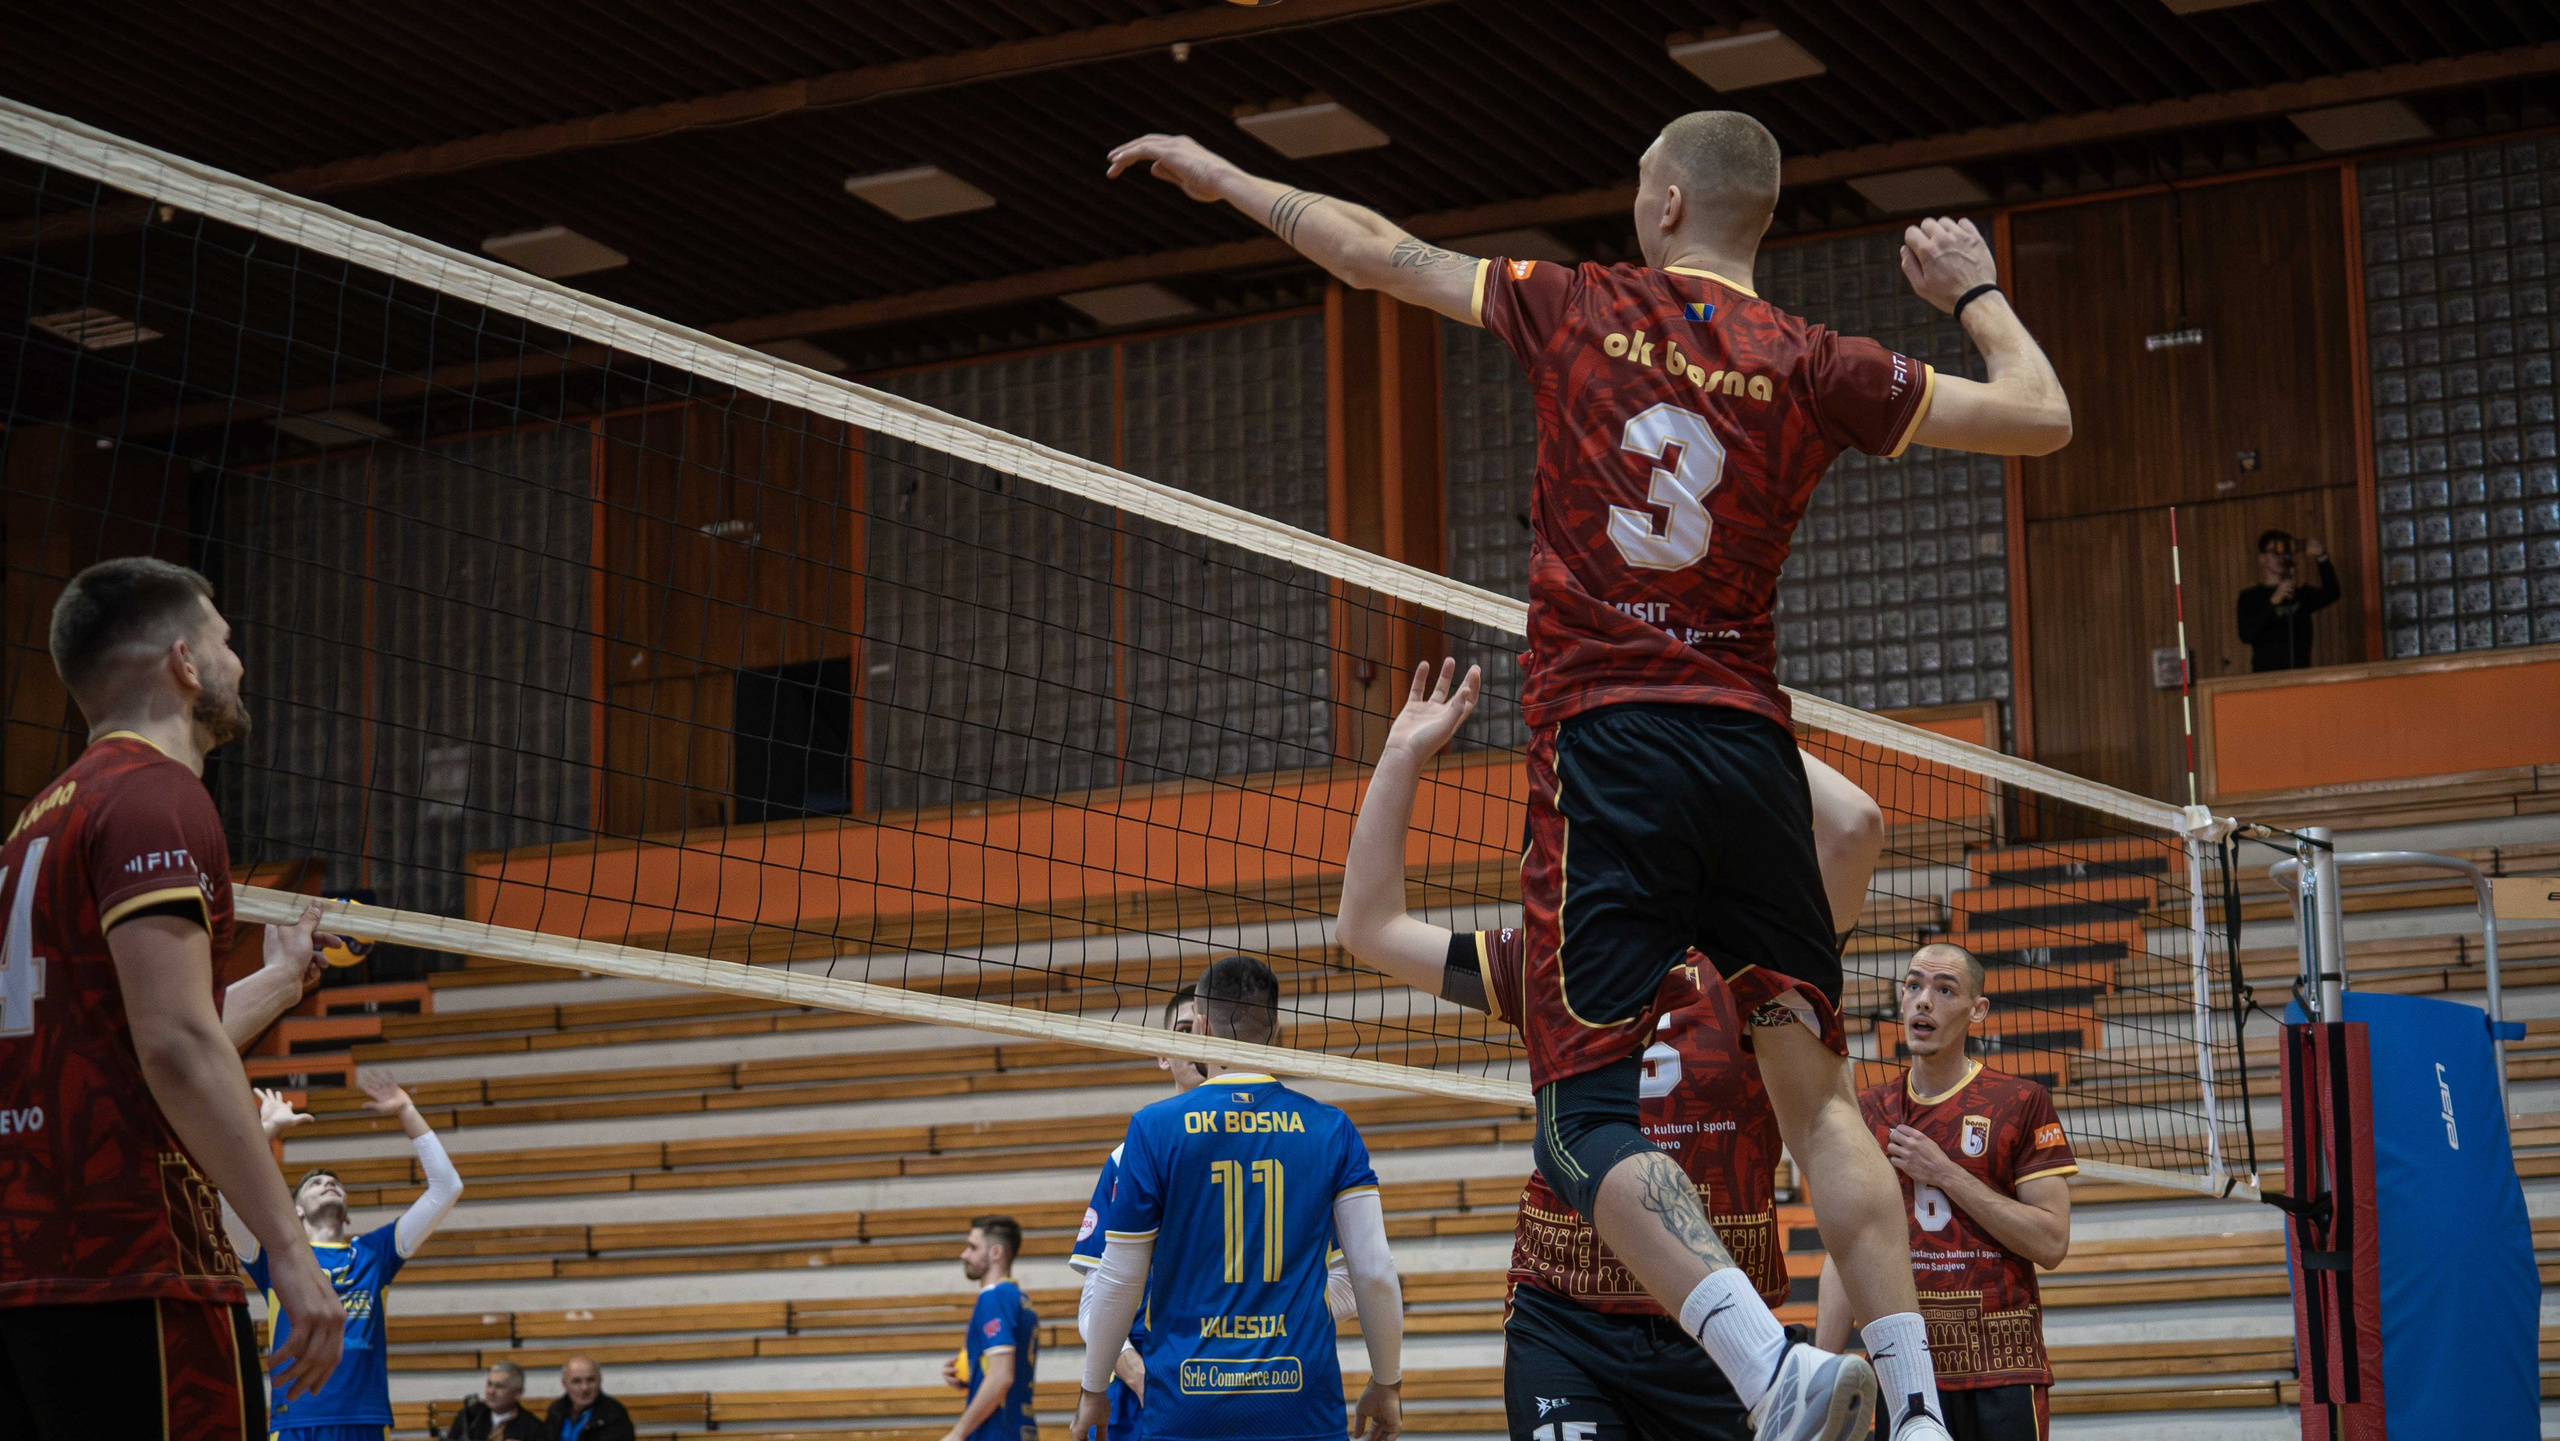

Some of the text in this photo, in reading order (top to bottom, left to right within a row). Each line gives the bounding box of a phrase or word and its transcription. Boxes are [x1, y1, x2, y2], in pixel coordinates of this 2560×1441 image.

[1603, 329, 1774, 402] ok bosna
[1606, 402, 1726, 572] 3
[2435, 1062, 2459, 1151] elan
[1184, 1110, 1306, 1134] OK BOSNA
[1653, 1121, 1694, 1135] kulture
[1696, 1121, 1700, 1133] i
[1703, 1120, 1737, 1134] sporta
[1653, 1139, 1682, 1151] jevo
[1211, 1158, 1284, 1283] 11
[1947, 1249, 1975, 1259] kulture
[1931, 1262, 1966, 1272] Sarajevo
[1184, 1365, 1207, 1388] Srle
[1209, 1365, 1270, 1388] Commerce
